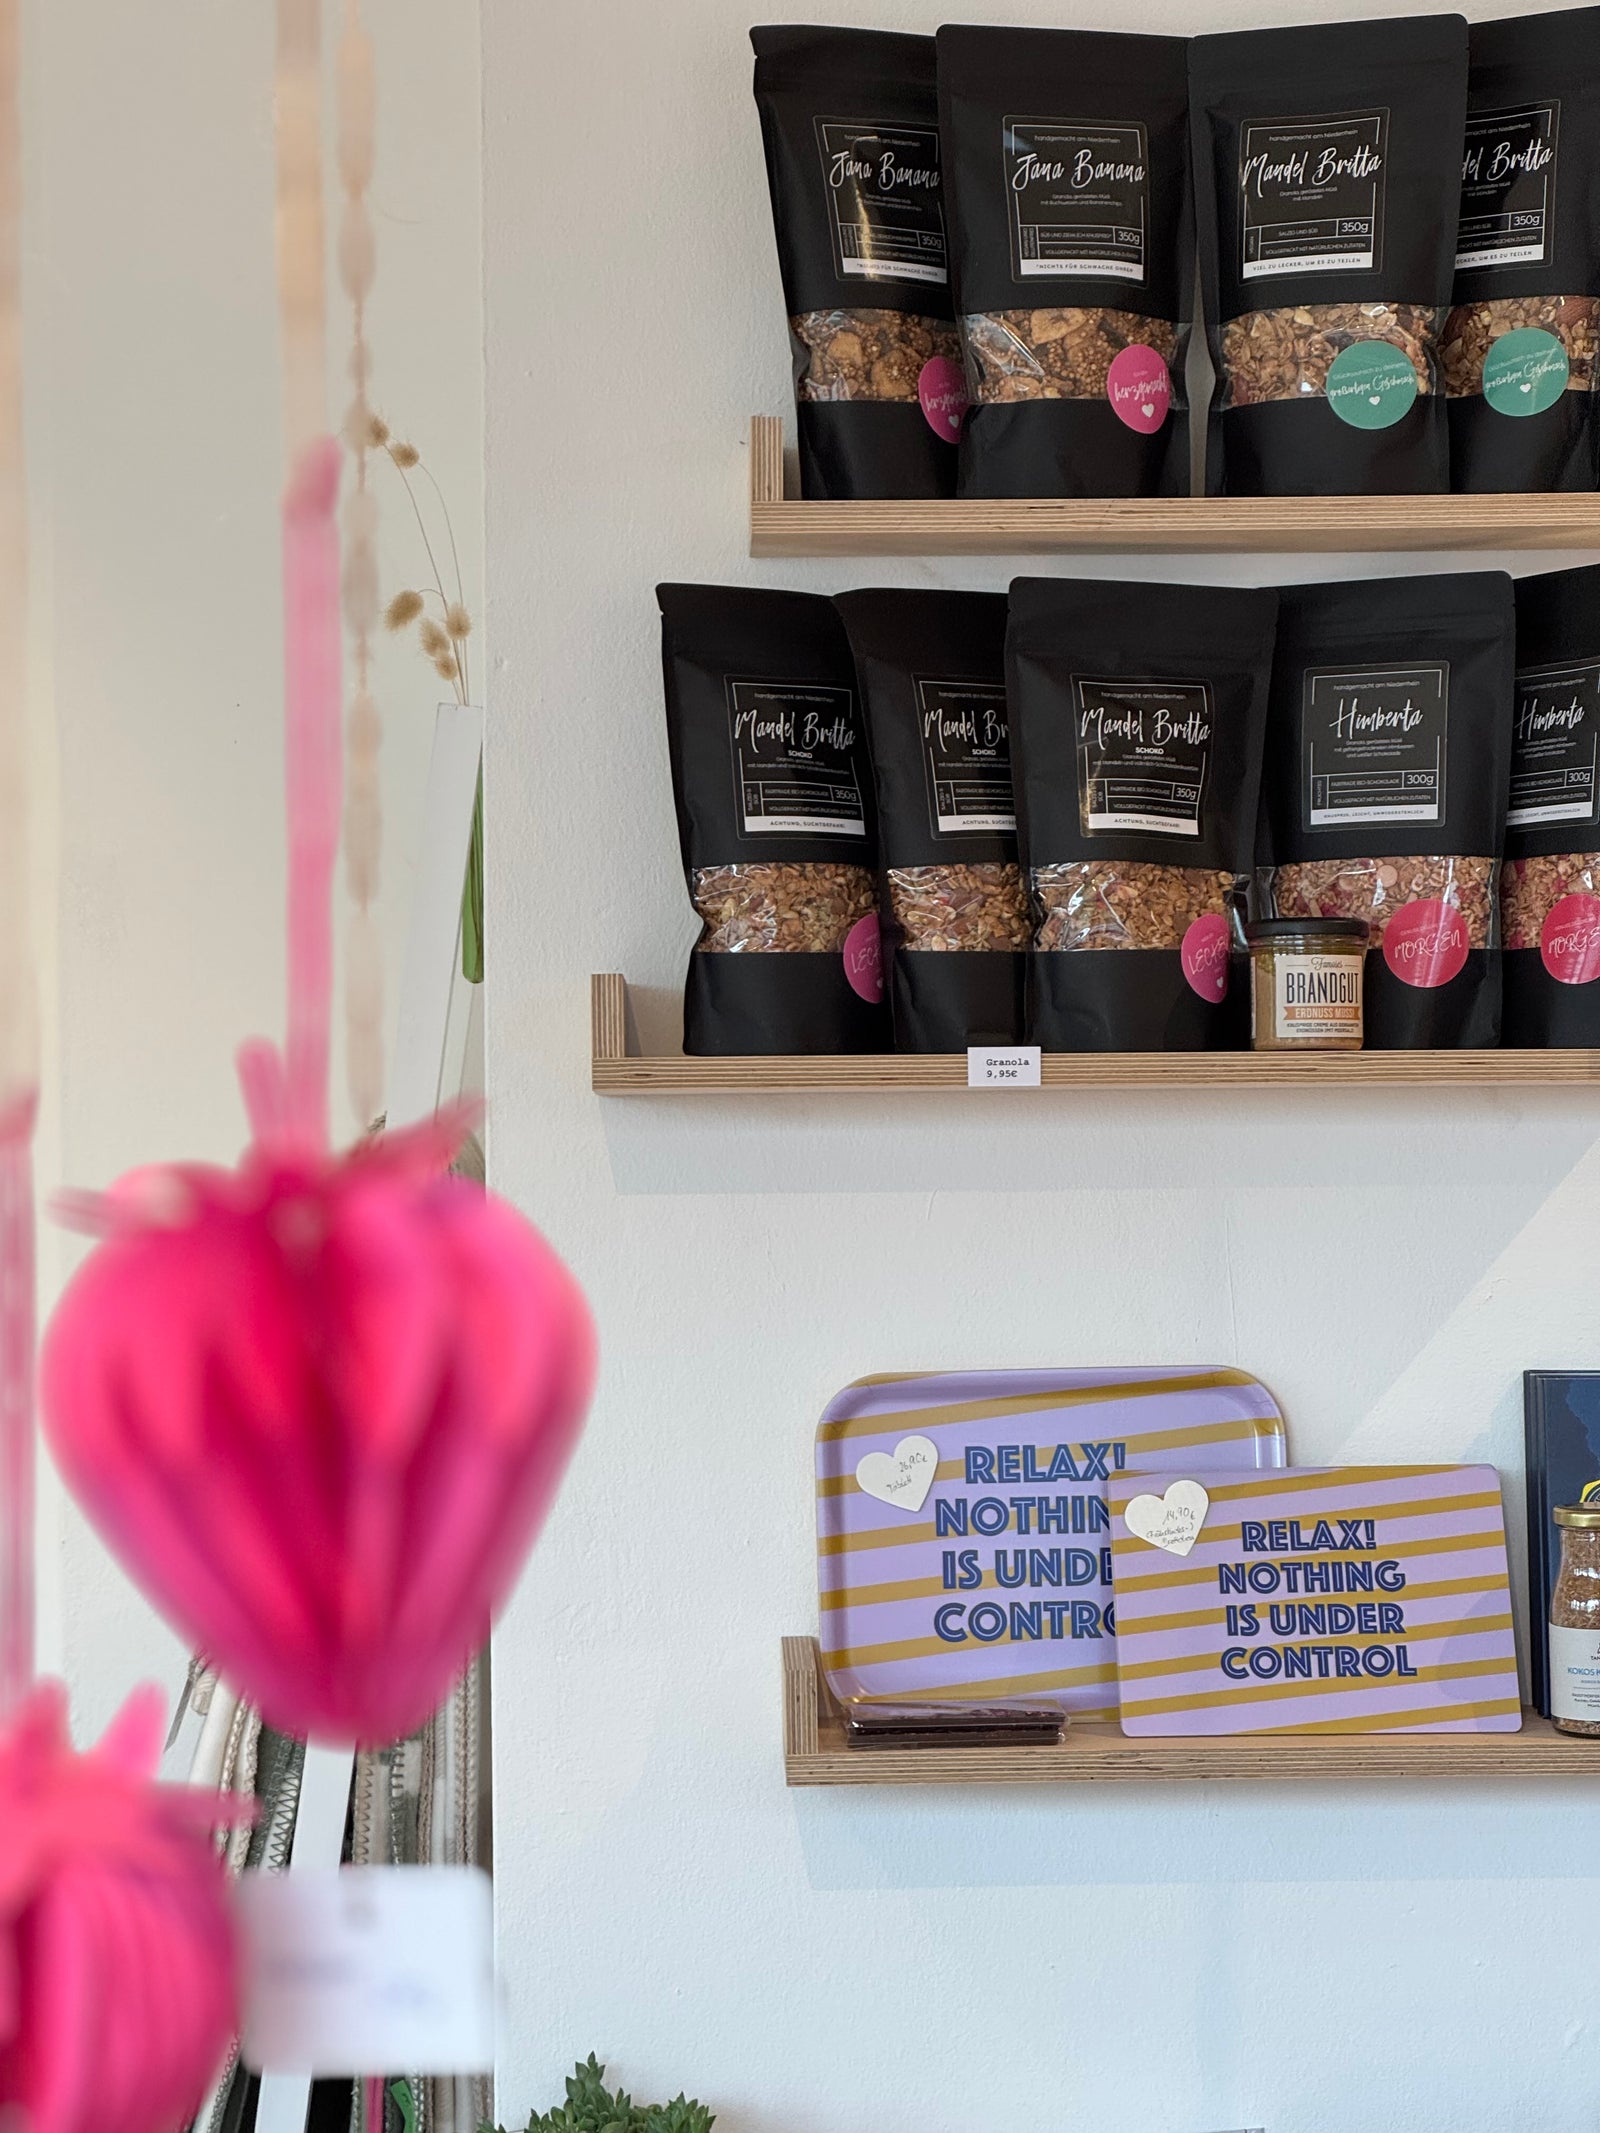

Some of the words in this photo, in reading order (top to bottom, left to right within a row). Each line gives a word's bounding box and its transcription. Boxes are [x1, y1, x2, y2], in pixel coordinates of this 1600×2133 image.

[829, 151, 872, 187] Jana
[878, 152, 940, 190] Banana
[1012, 153, 1064, 190] Jana
[1071, 149, 1145, 189] Banana
[1242, 151, 1309, 198] Mandel
[1311, 144, 1383, 186] Britta
[1487, 138, 1553, 181] Britta
[1341, 221, 1369, 233] 350g
[1514, 215, 1540, 227] 350g
[921, 235, 942, 249] 350g
[1118, 231, 1140, 245] 350g
[734, 709, 795, 753] Mandel
[801, 712, 856, 750] Britta
[924, 708, 978, 753] Mandel
[1081, 707, 1144, 751] Mandel
[1151, 709, 1211, 746] Britta
[1329, 698, 1423, 739] Himberta
[1514, 696, 1585, 740] Himberta
[1135, 747, 1164, 755] SCHOKO
[1176, 787, 1197, 800] 350g
[1407, 774, 1434, 786] 300g
[1568, 772, 1590, 783] 300g
[834, 789, 857, 802] 350g
[1394, 929, 1463, 963] MORGEN
[1286, 972, 1359, 1004] BRANDGUT
[1295, 1008, 1333, 1018] ERDNUSS
[986, 1058, 1030, 1066] Granola
[986, 1069, 1018, 1079] 9,95€
[965, 1442, 1126, 1484] RELAX!
[1241, 1519, 1377, 1552] RELAX!
[941, 1549, 983, 1590] IS
[1218, 1559, 1406, 1594] NOTHING
[1226, 1604, 1261, 1637] IS
[1270, 1602, 1407, 1636] UNDER
[1220, 1644, 1418, 1680] CONTROL
[1568, 1667, 1595, 1676] KOKOS
